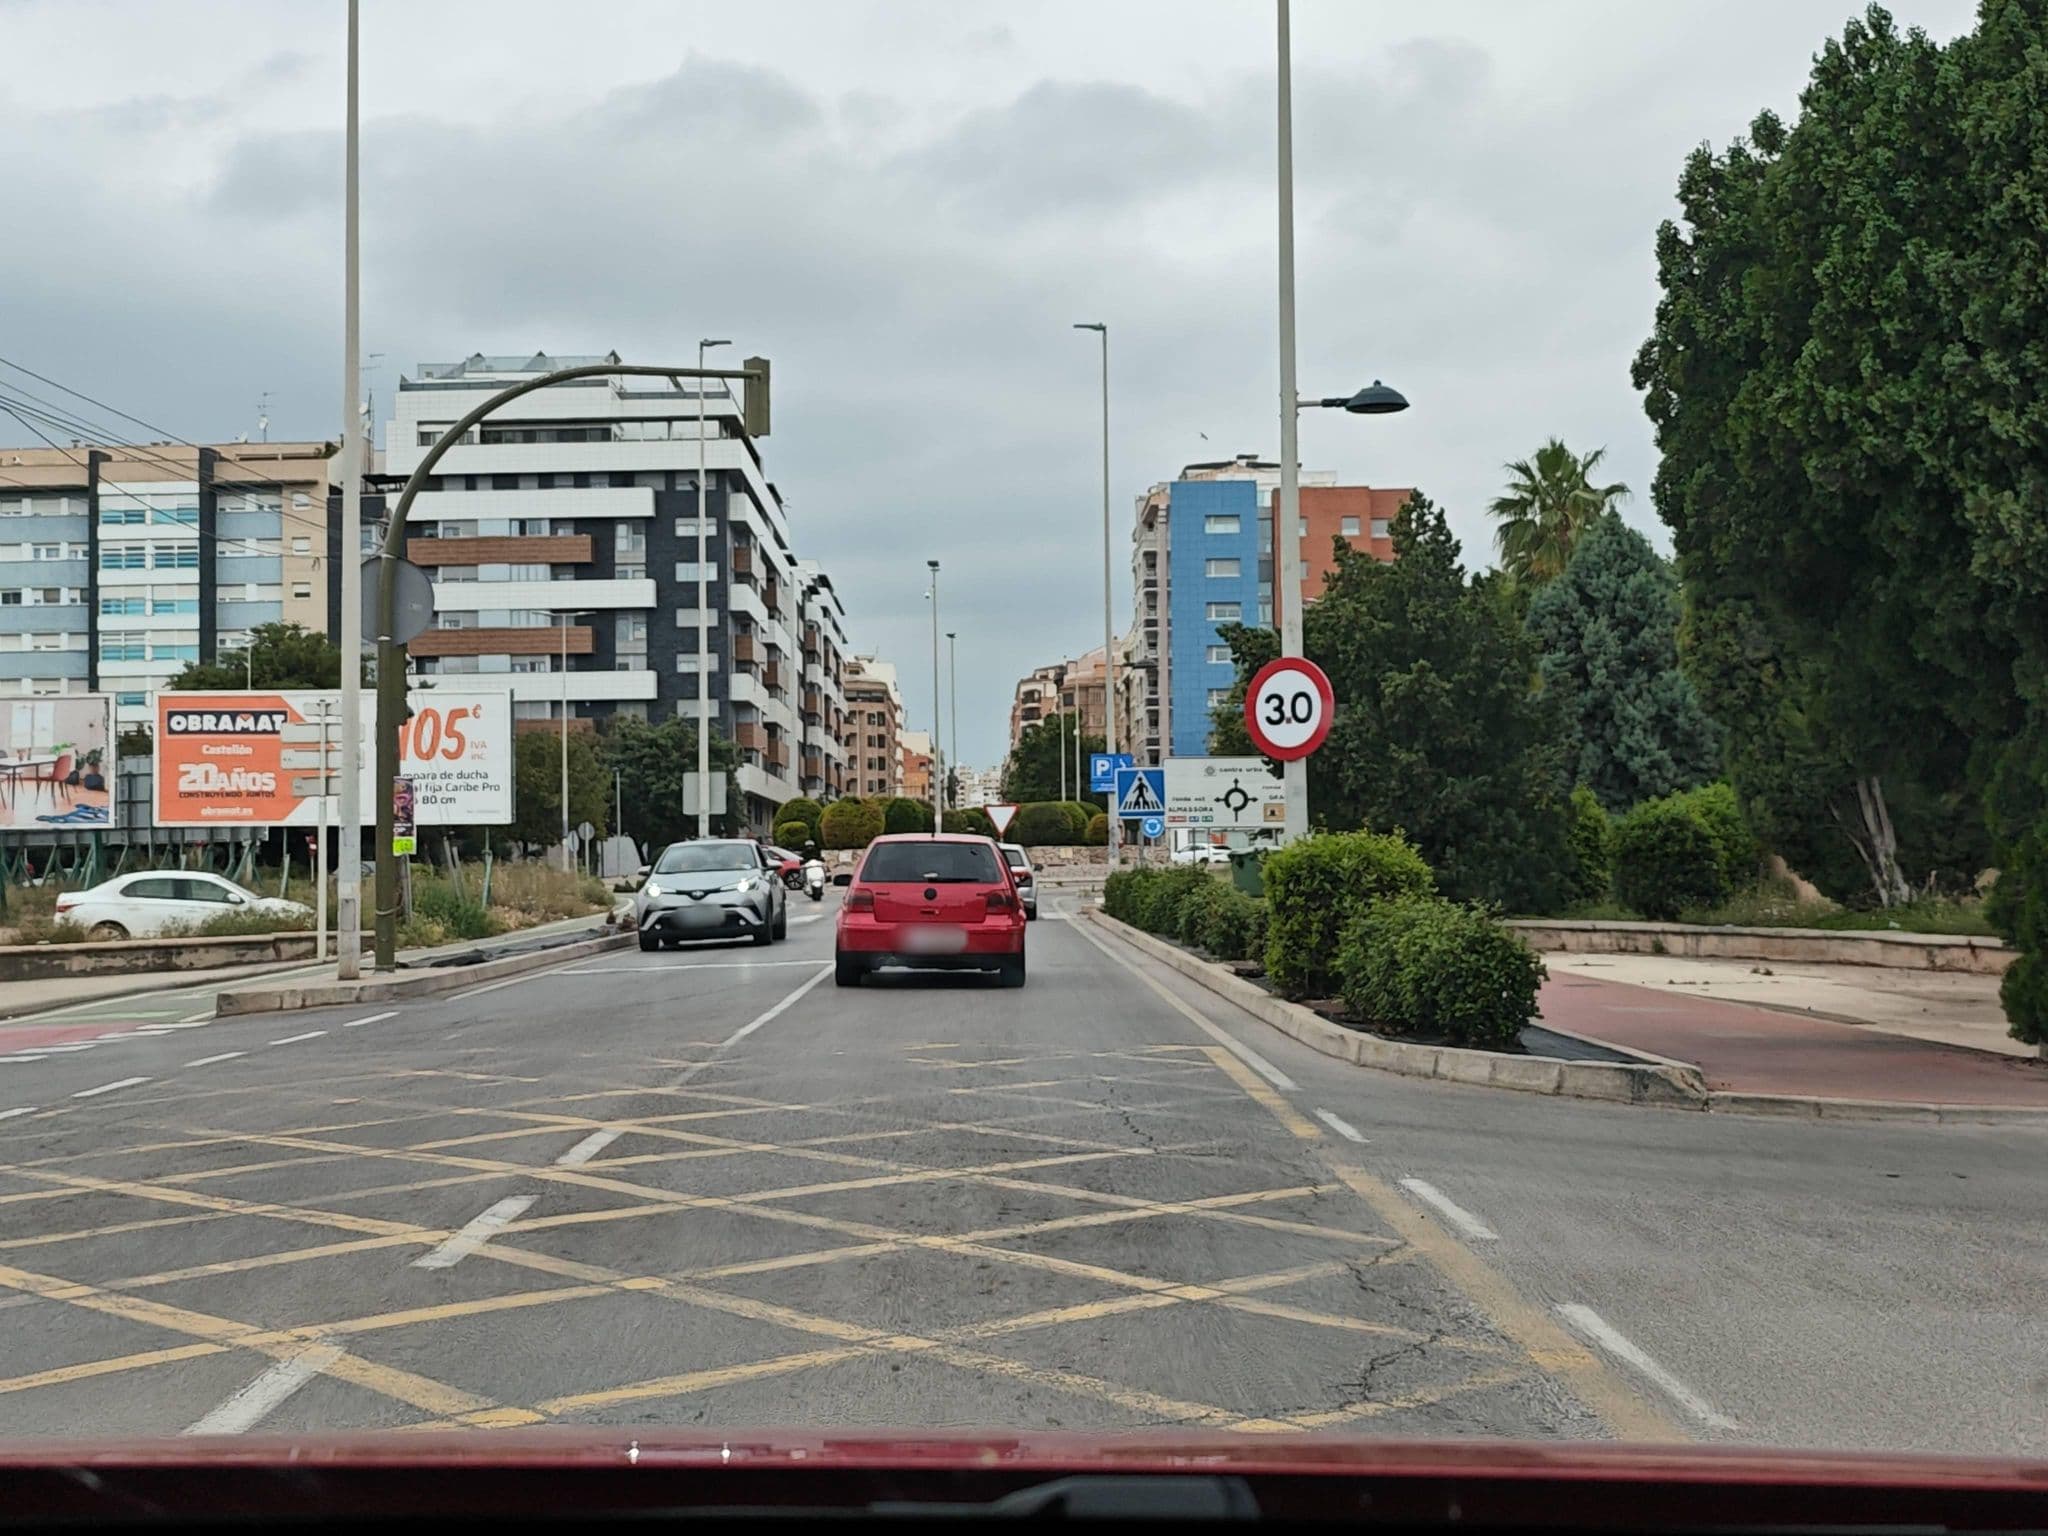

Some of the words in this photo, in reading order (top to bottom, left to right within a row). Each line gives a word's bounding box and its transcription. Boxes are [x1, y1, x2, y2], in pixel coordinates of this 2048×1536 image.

[1264, 691, 1313, 726] 30
[170, 714, 285, 731] OBRAMAT
[202, 744, 252, 755] Castellón
[470, 740, 488, 749] IVA
[1096, 759, 1110, 777] P
[402, 772, 437, 782] mpara
[440, 770, 454, 780] de
[456, 769, 489, 780] ducha
[425, 783, 443, 794] fija
[445, 783, 480, 792] Caribe
[482, 783, 501, 792] Pro
[178, 791, 242, 799] CONSTRUYENDO
[245, 791, 276, 799] JUNTOS
[421, 795, 437, 805] 80
[440, 797, 457, 805] cm
[201, 806, 253, 816] obramat.es
